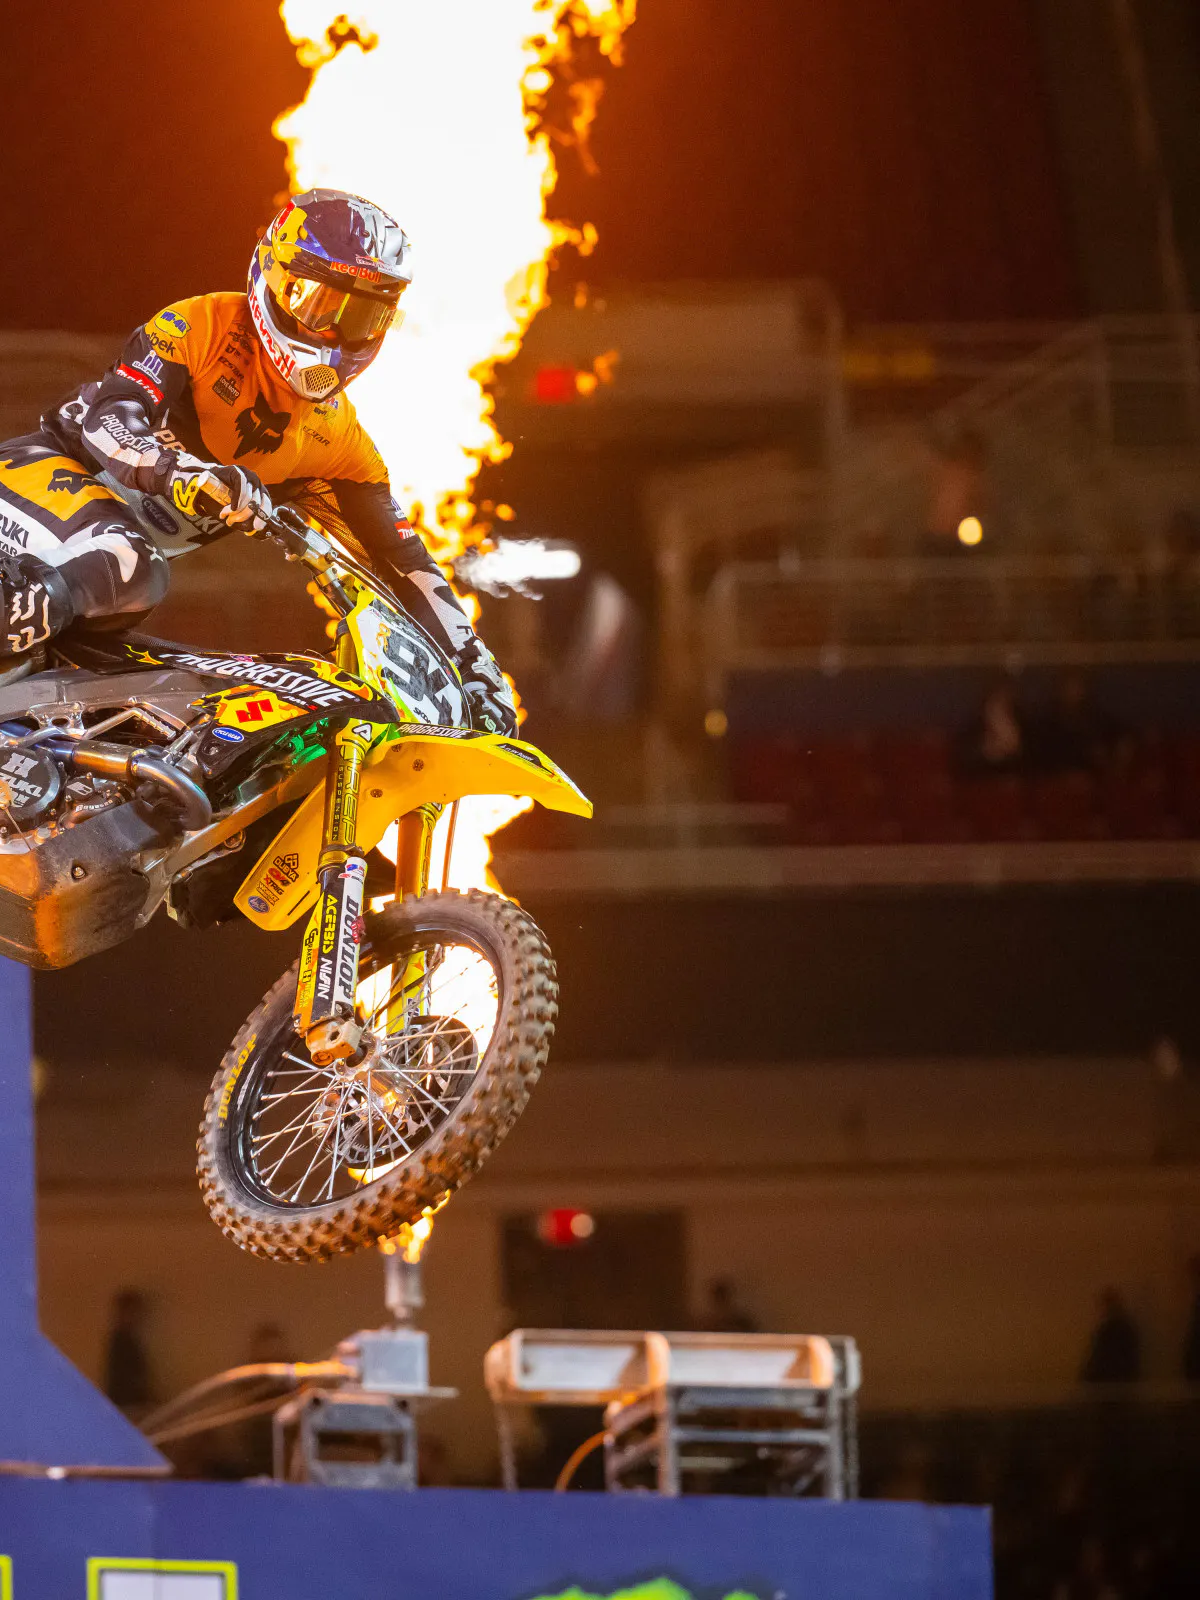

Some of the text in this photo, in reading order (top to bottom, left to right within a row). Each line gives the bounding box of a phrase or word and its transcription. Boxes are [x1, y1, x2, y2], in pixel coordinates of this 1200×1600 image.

[158, 652, 358, 708] PROGRESSIVE
[397, 723, 472, 739] PROGRESSIVE
[331, 766, 345, 842] SUSPENSION
[264, 873, 285, 896] XTRIG
[274, 856, 299, 882] DUBYA
[338, 895, 359, 1000] DUNLOP
